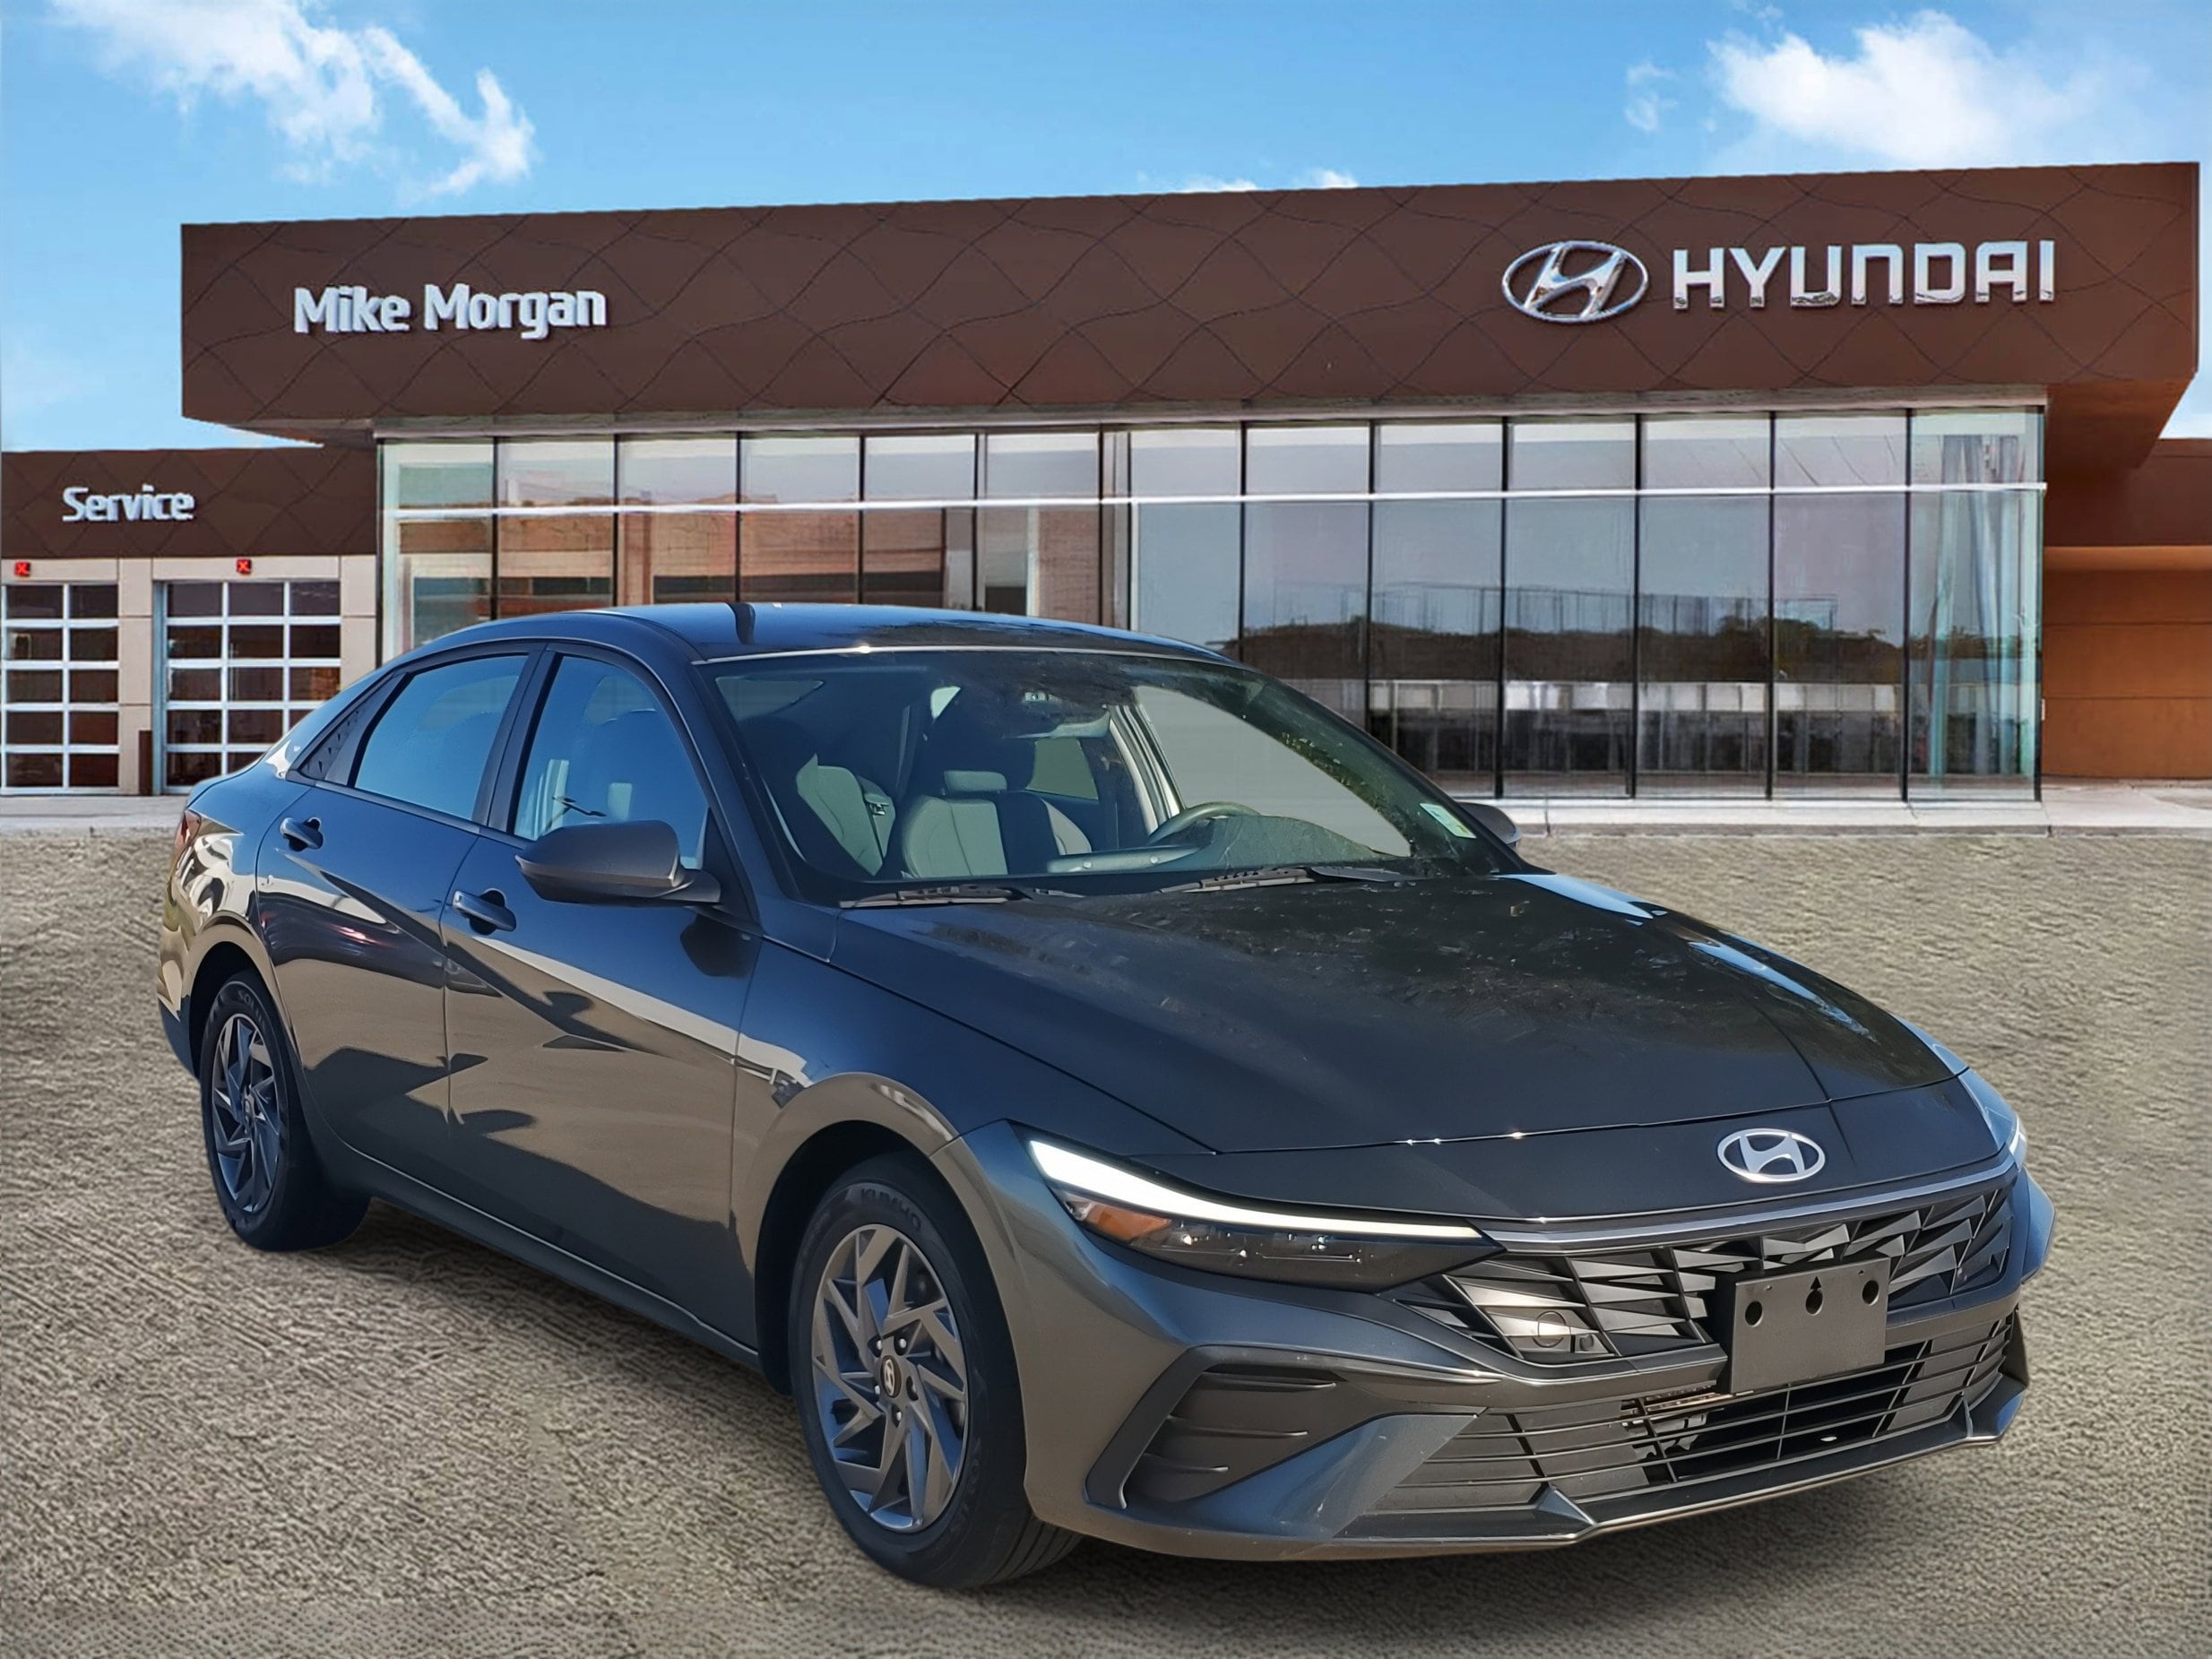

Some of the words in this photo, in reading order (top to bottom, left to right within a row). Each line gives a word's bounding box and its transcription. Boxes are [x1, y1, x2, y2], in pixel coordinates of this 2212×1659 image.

[1672, 239, 2055, 310] HYUNDAI
[294, 285, 410, 333] Mike
[424, 283, 607, 340] Morgan
[62, 484, 195, 522] Service
